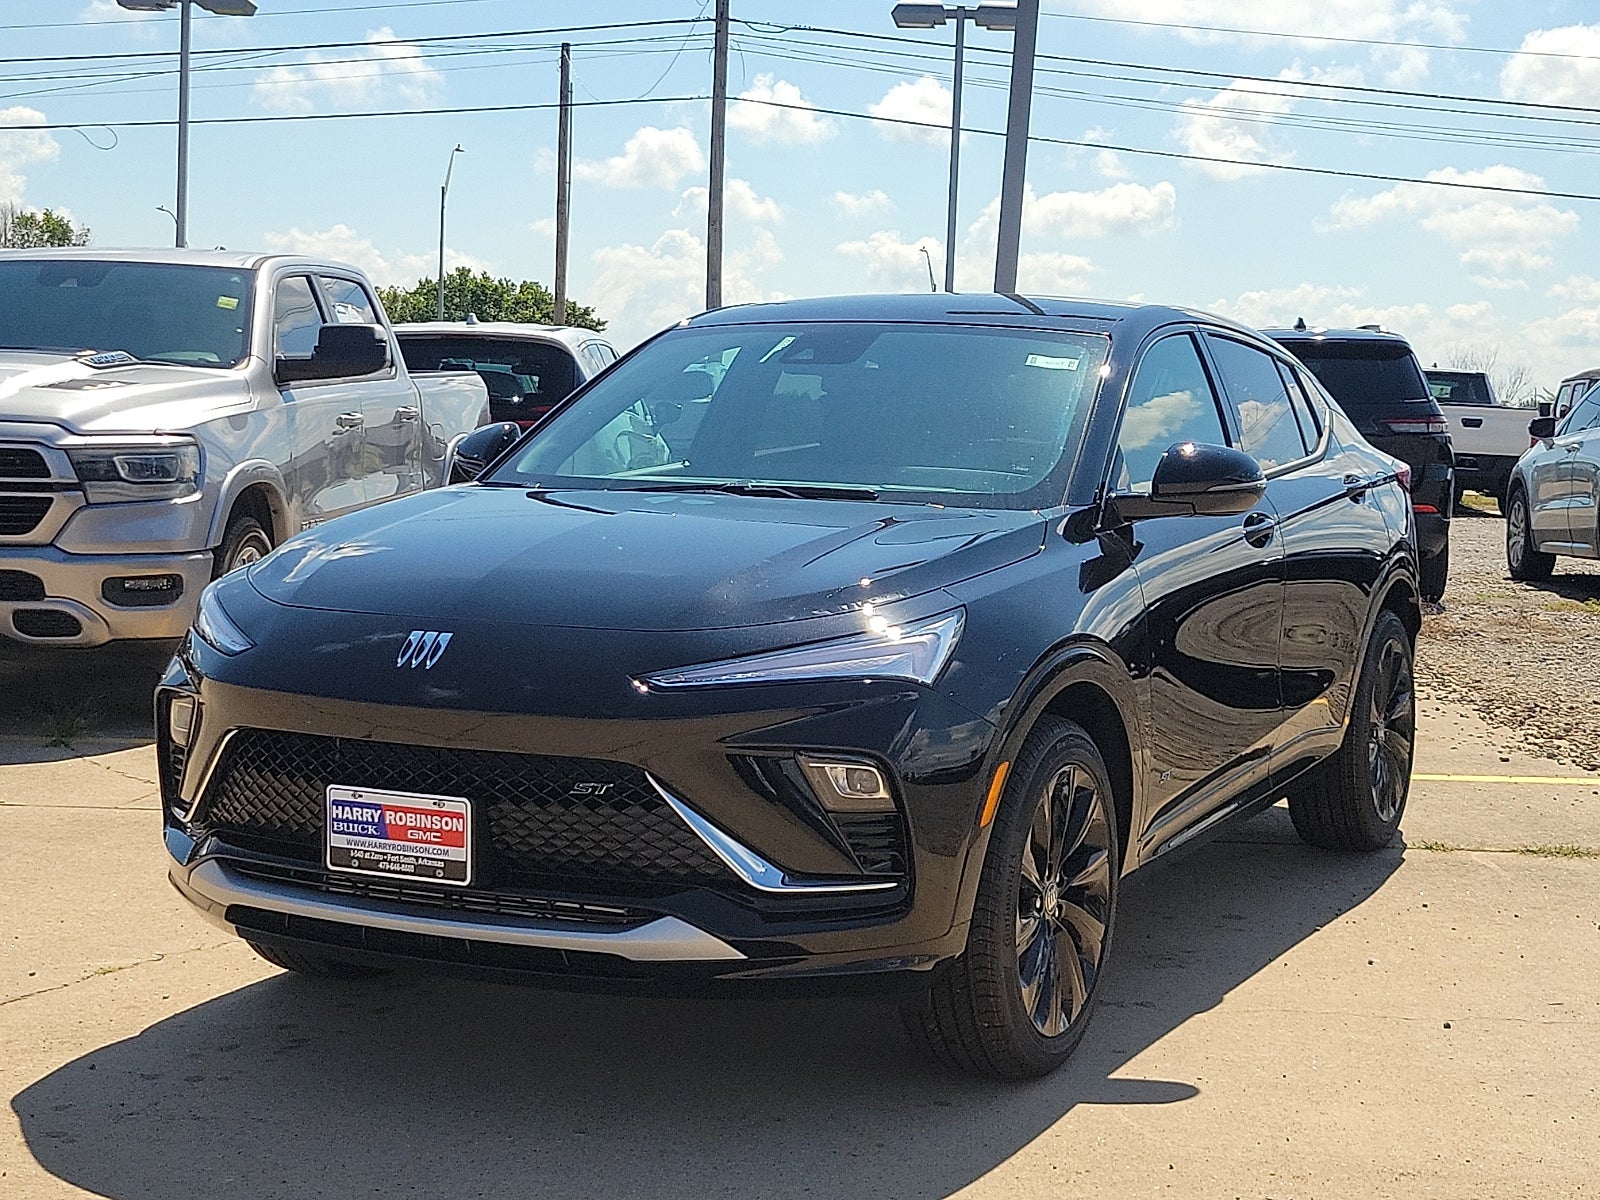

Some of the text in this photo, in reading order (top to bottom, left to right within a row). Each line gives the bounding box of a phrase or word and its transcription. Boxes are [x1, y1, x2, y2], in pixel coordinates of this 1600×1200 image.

[569, 782, 614, 795] ST
[332, 805, 463, 832] HARRY ROBINSON
[333, 821, 443, 842] BUICK GMC
[346, 838, 450, 857] WWW.HARRYROBINSON.COM
